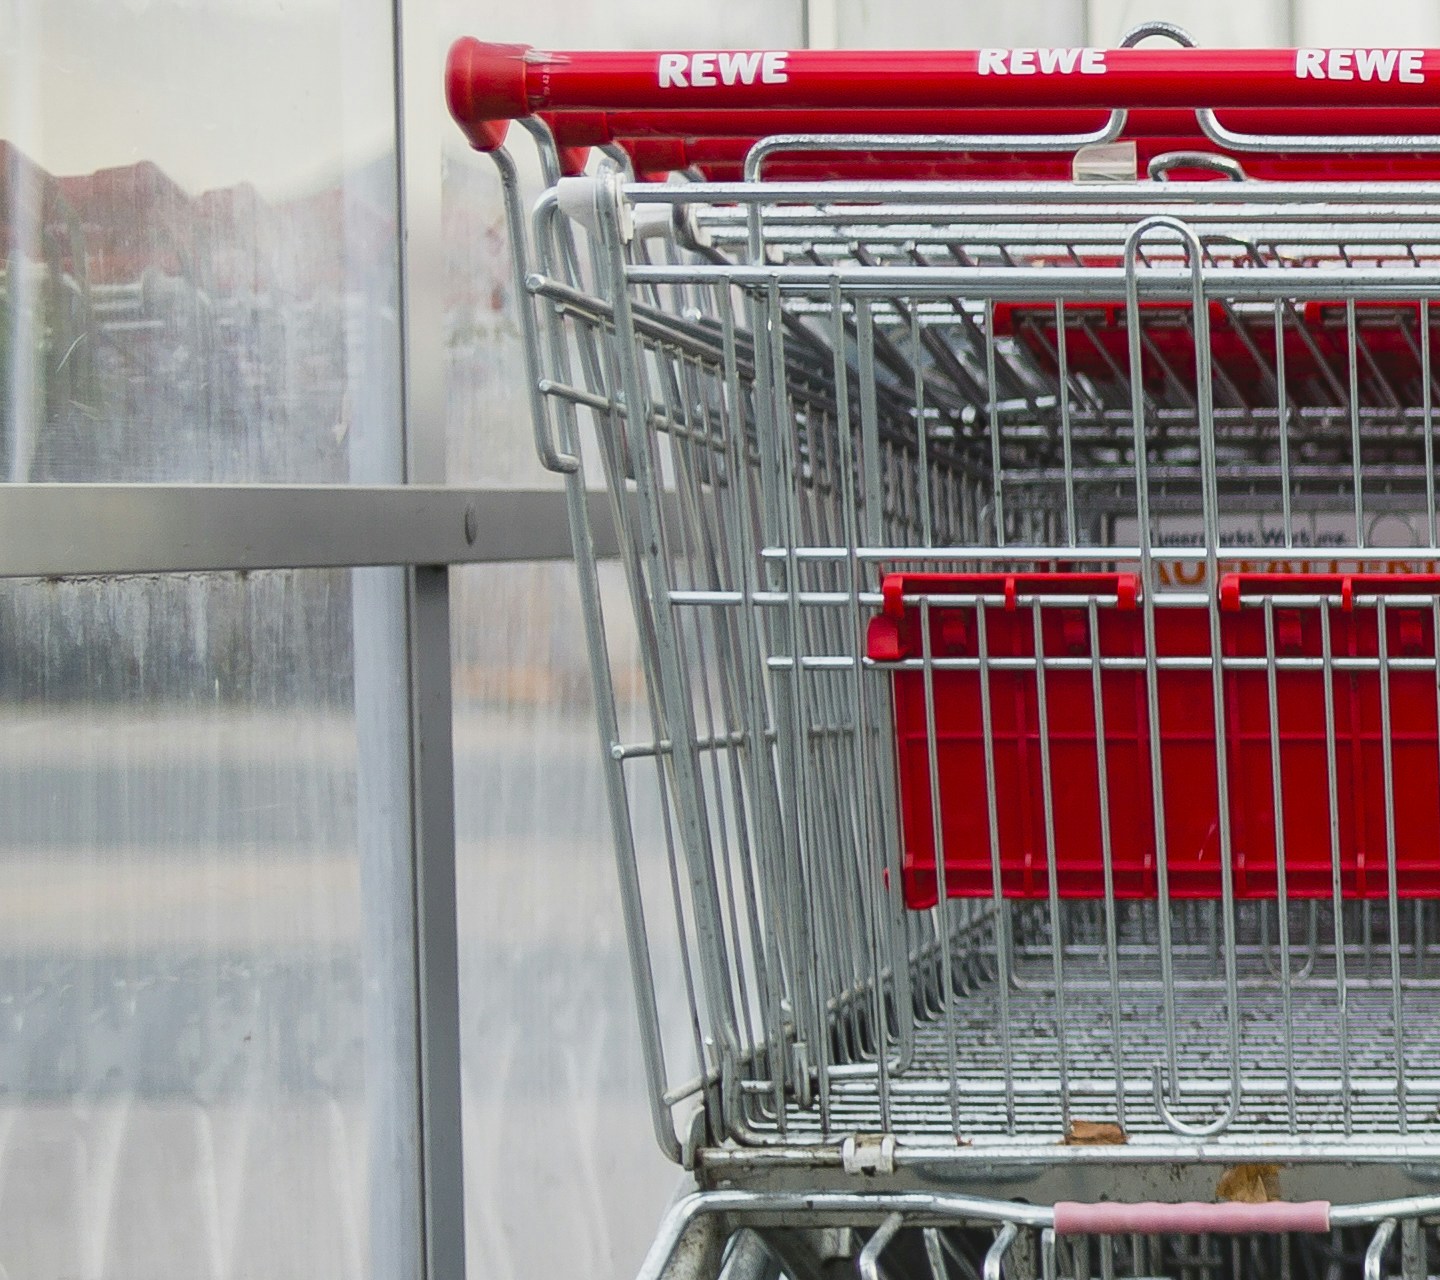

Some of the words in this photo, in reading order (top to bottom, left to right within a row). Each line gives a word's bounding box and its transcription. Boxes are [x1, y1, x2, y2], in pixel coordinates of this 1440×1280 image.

[658, 51, 789, 89] REWE
[977, 47, 1107, 75] REWE
[1295, 48, 1425, 84] REWE
